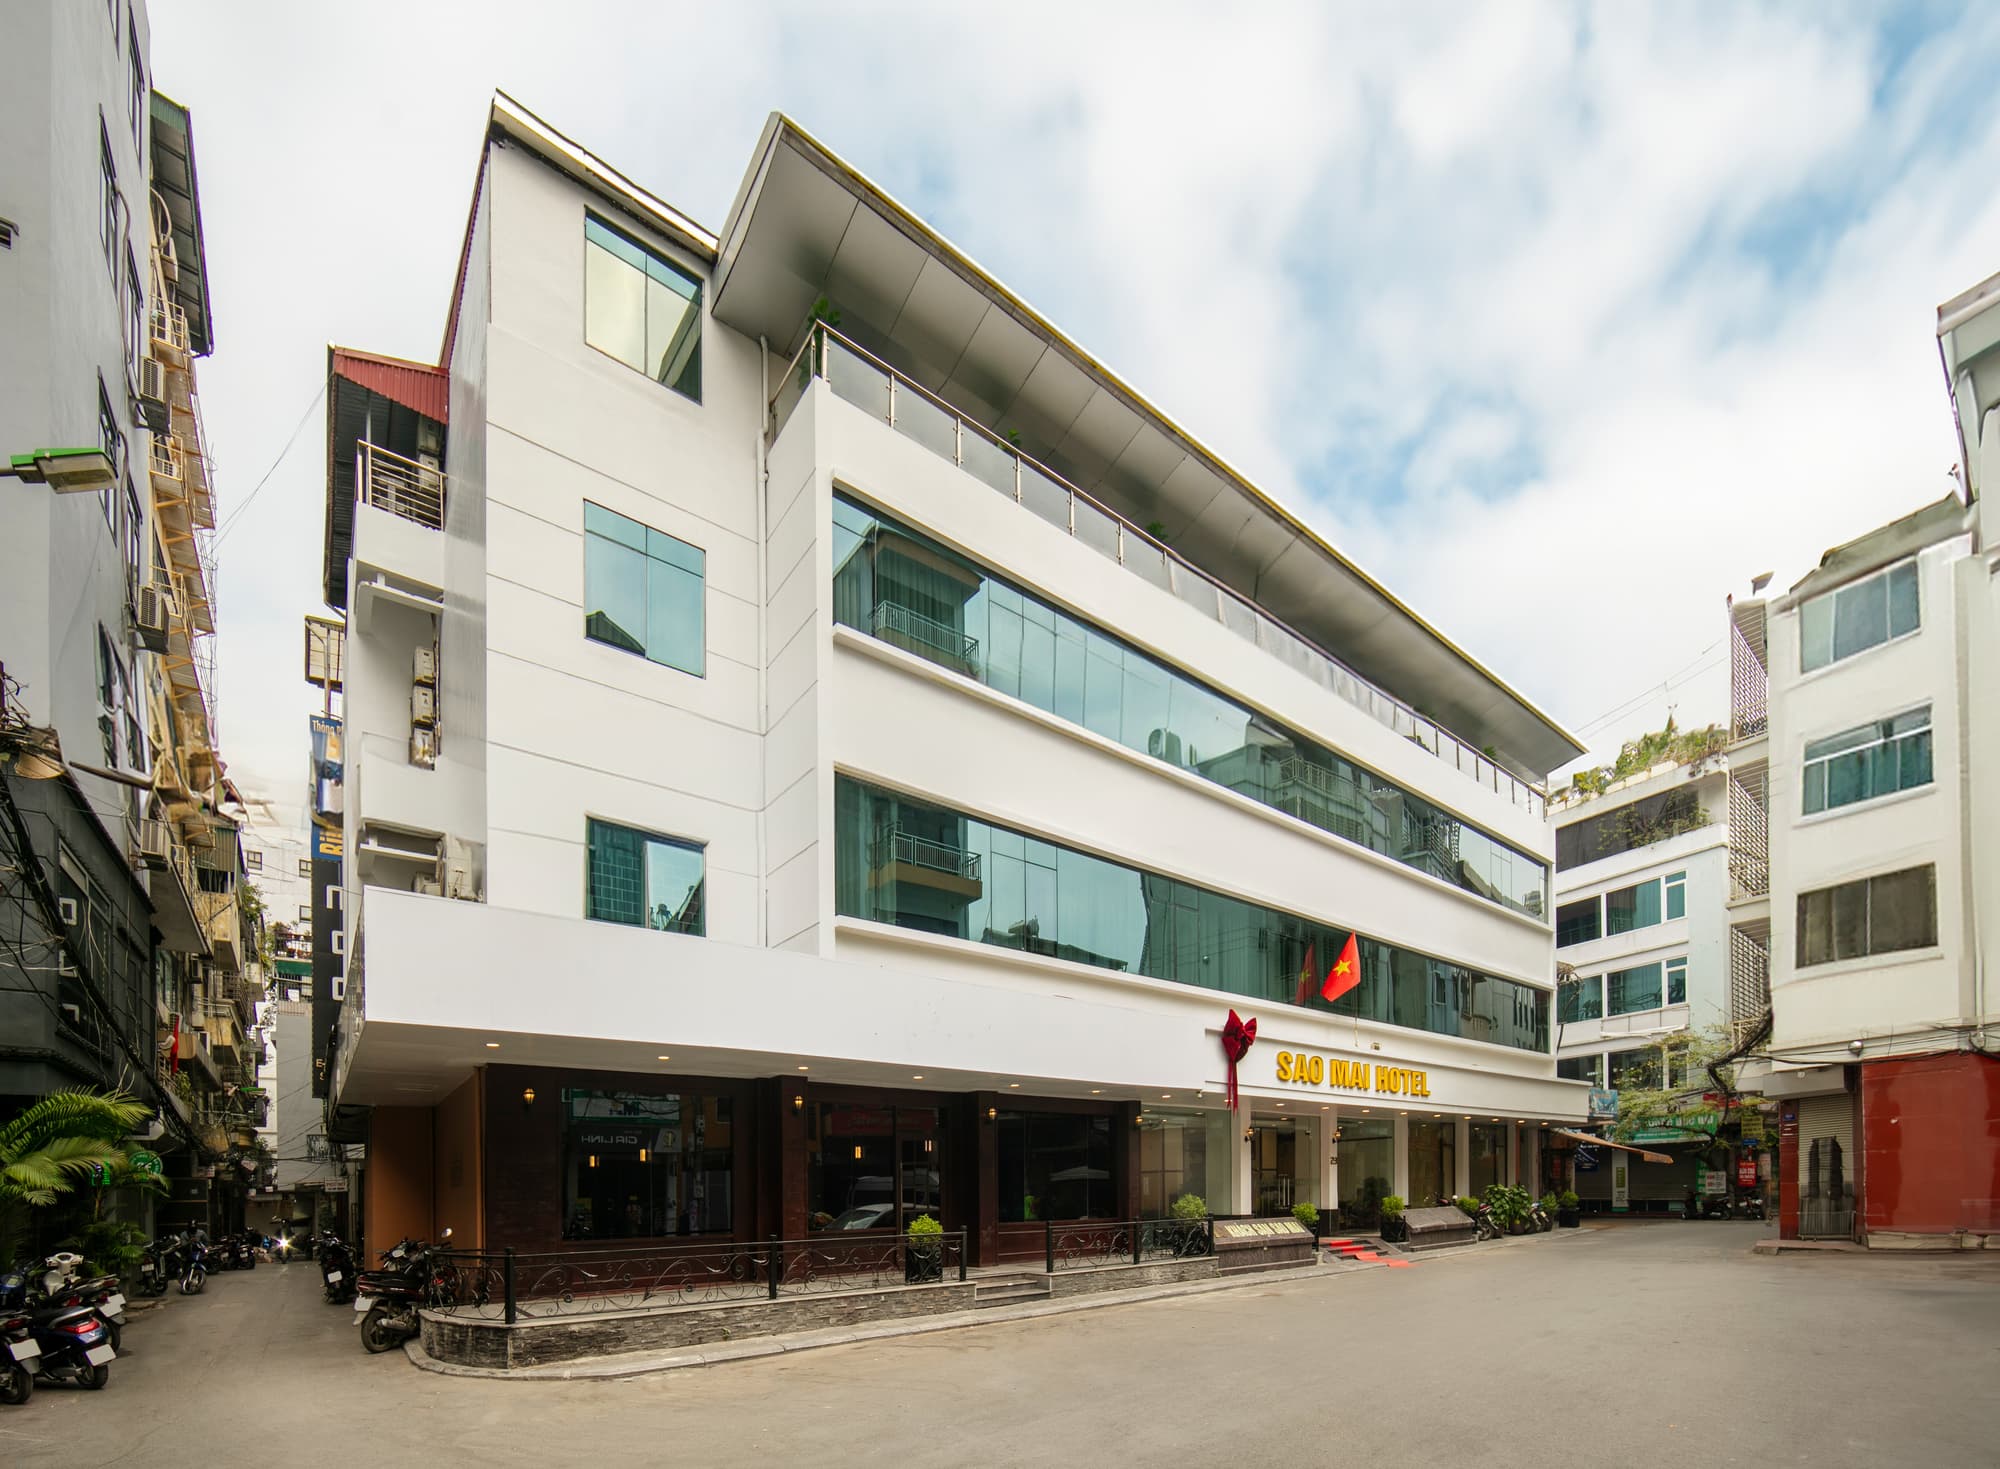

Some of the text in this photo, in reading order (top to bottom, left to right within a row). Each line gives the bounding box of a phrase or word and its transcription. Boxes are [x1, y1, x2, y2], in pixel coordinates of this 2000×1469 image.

[1276, 1050, 1431, 1097] SAO MAI HOTEL
